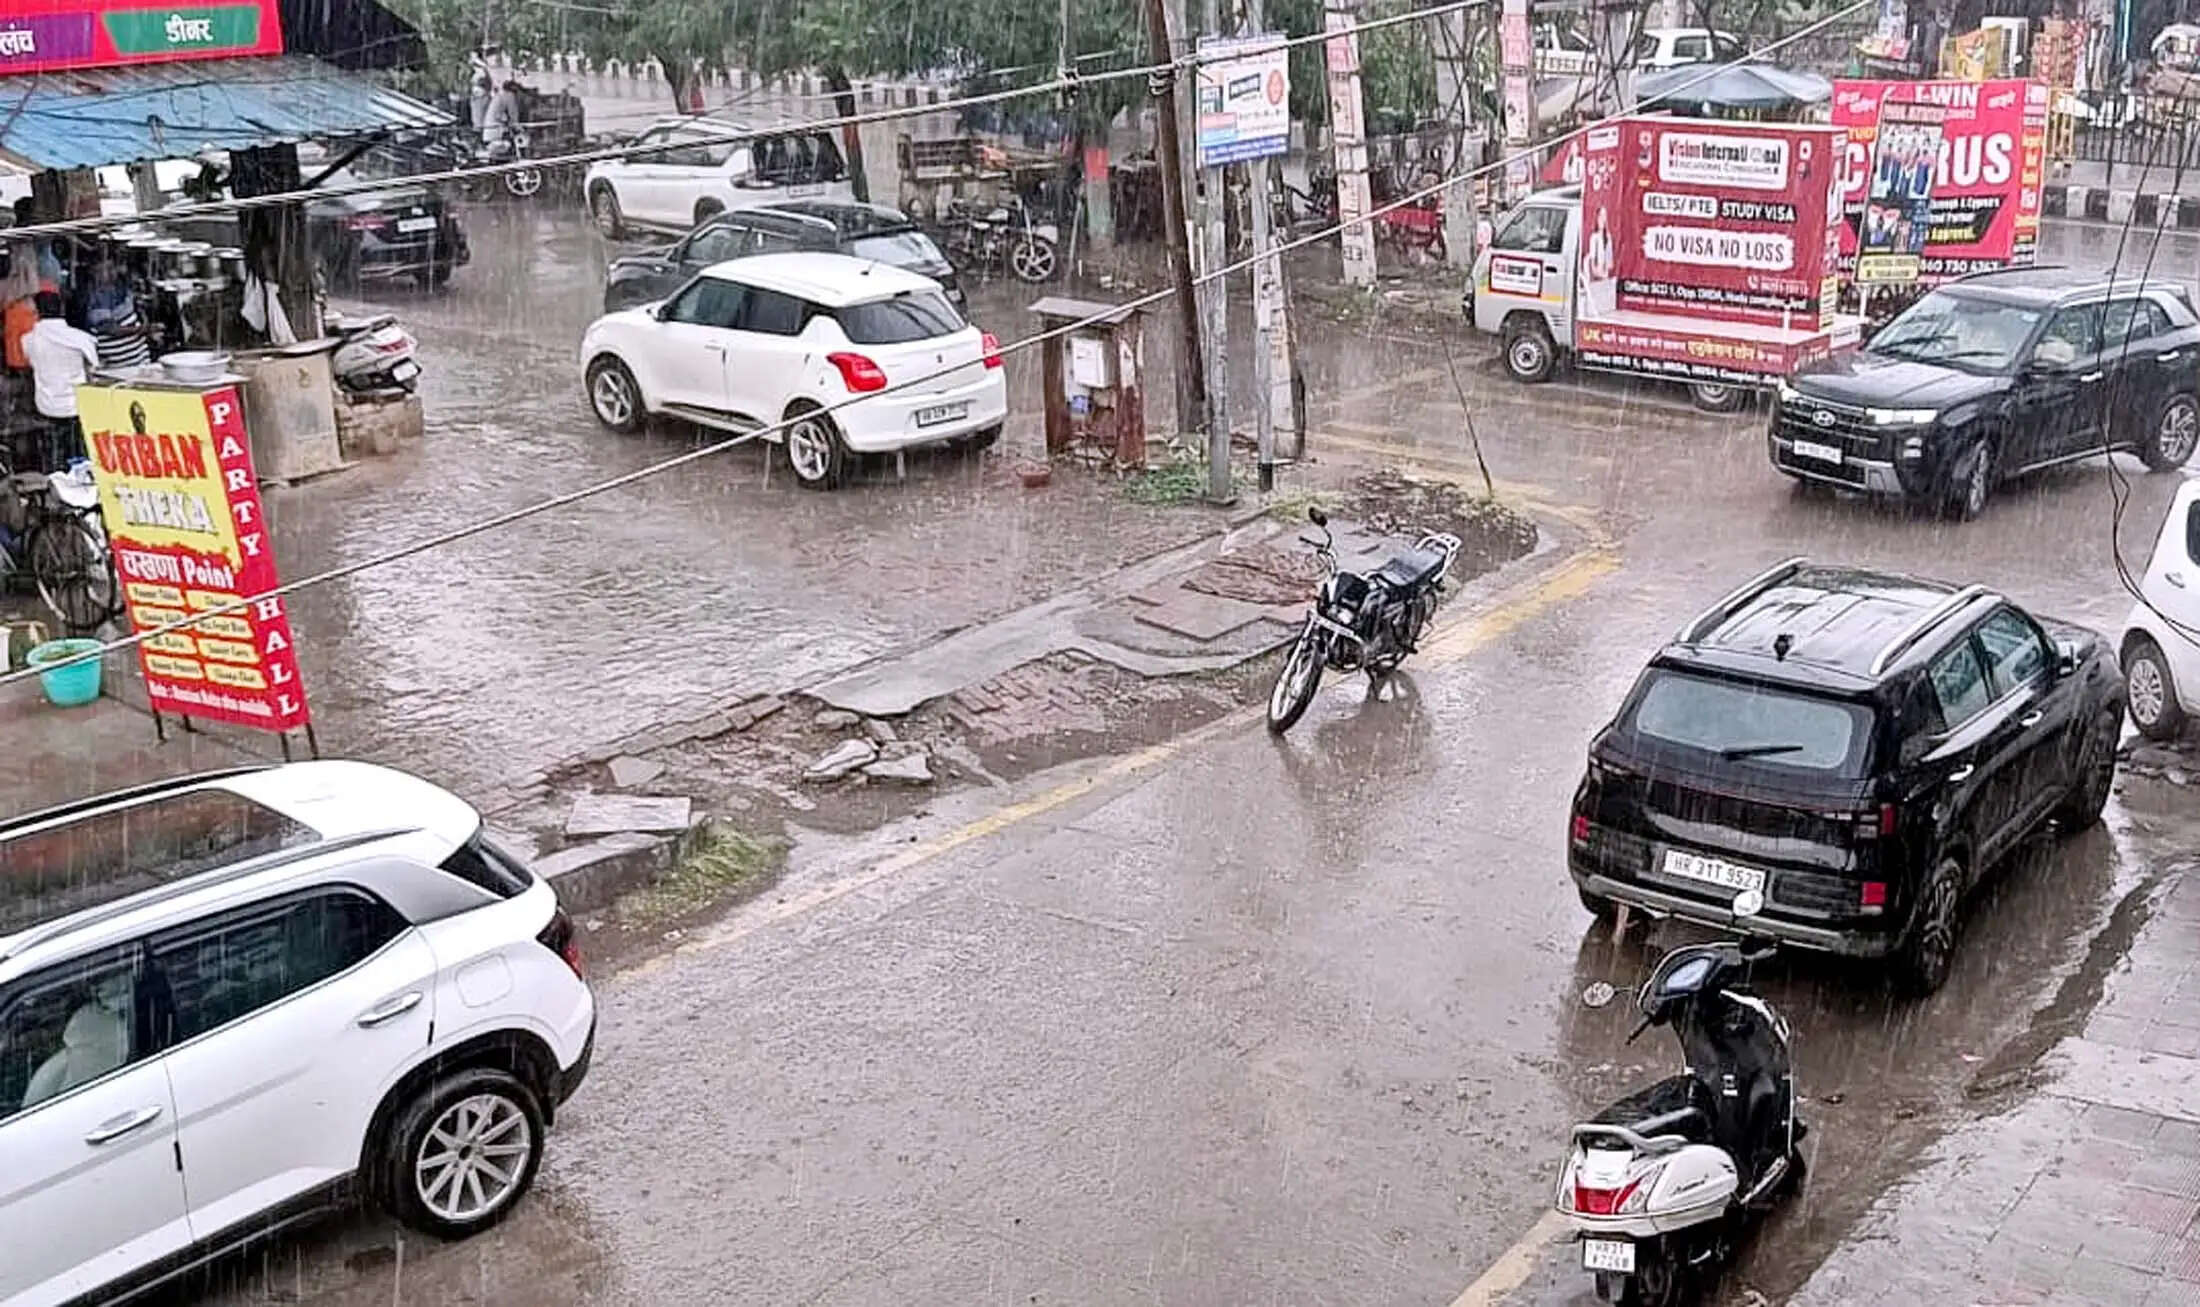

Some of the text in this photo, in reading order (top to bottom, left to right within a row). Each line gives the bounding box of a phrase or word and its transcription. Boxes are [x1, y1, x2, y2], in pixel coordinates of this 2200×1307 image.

[165, 14, 214, 42] डीनर
[1689, 199, 1713, 214] PTE
[1722, 201, 1763, 218] STUDY
[1764, 204, 1796, 221] VISA
[1654, 233, 1785, 263] NO VISA NO LOSS
[92, 430, 208, 479] URBAN
[209, 402, 261, 557] PARTY
[112, 483, 219, 536] THEKA
[181, 554, 235, 589] Point
[255, 596, 301, 717] HALL
